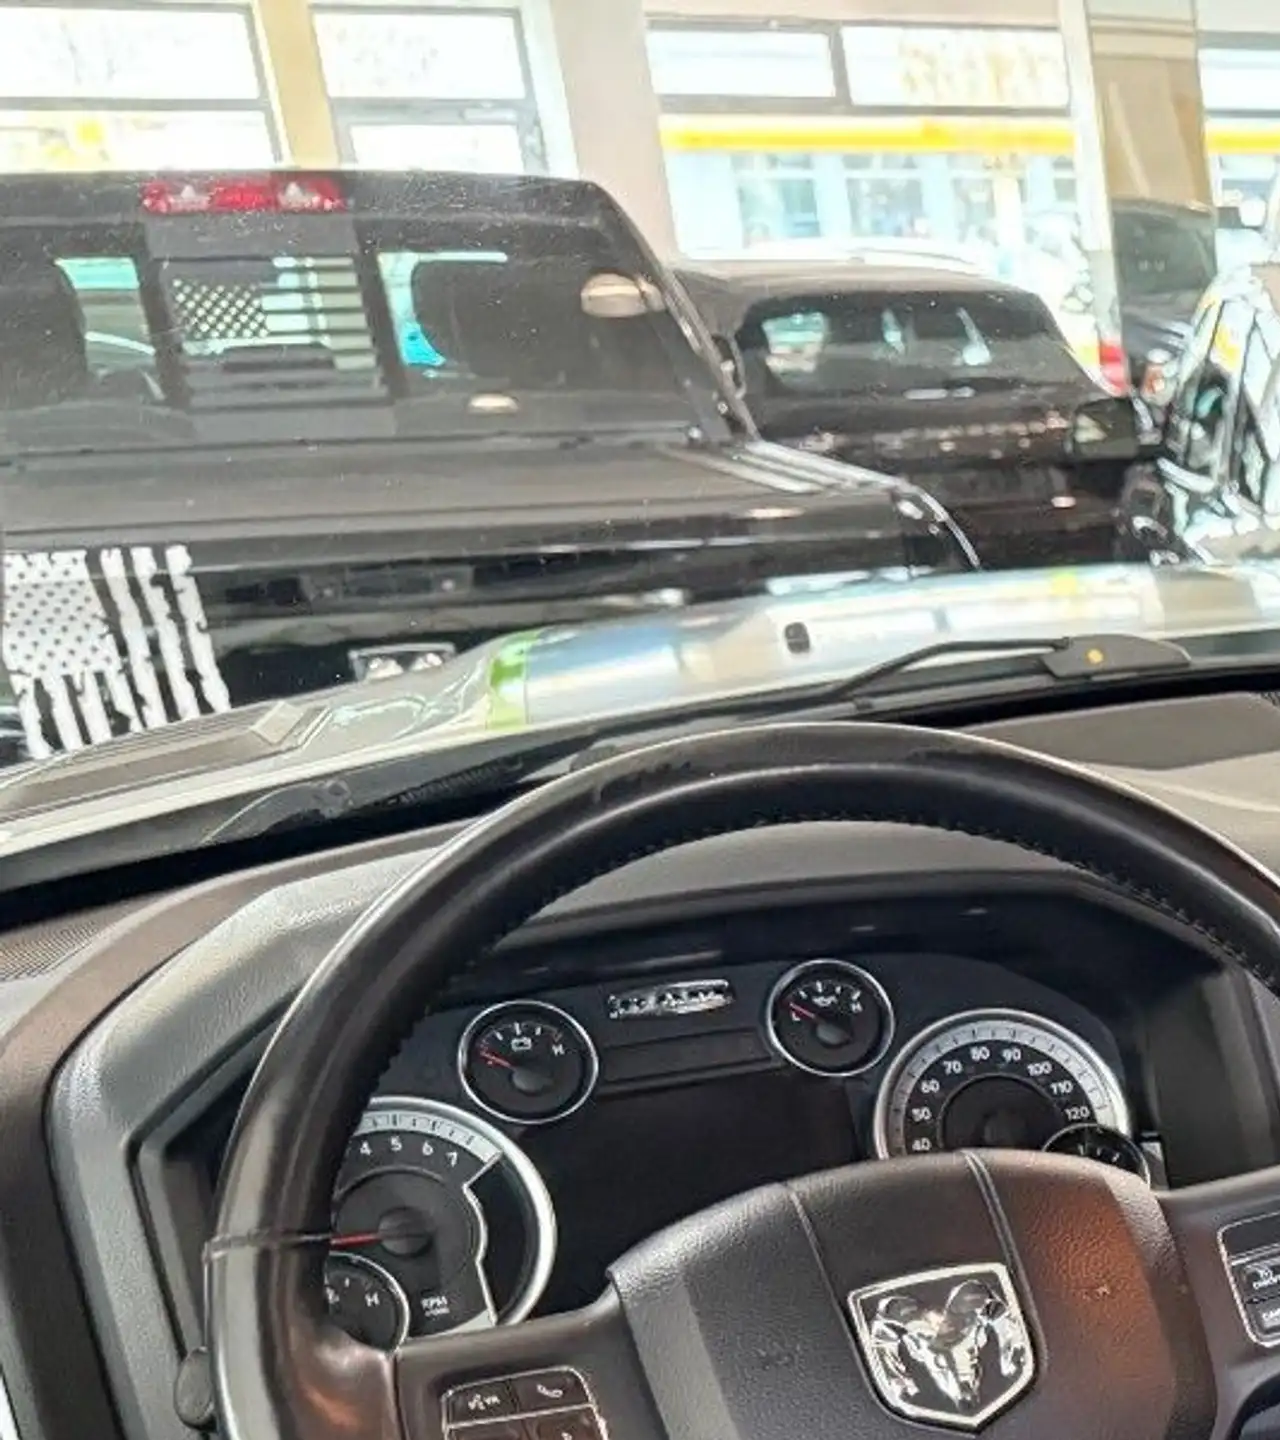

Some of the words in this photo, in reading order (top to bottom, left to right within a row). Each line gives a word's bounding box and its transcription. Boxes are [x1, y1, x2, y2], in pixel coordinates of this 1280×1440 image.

[969, 1046, 990, 1061] 80
[1002, 1048, 1021, 1062] 90
[943, 1060, 962, 1074] 70
[1027, 1062, 1052, 1076] 100
[920, 1079, 940, 1094] 60
[1051, 1081, 1074, 1096] 110
[912, 1107, 931, 1121] 50
[1064, 1107, 1090, 1121] 120
[360, 1142, 371, 1155] 4
[390, 1137, 402, 1151] 5
[422, 1142, 434, 1155] 6
[447, 1151, 458, 1166] 7
[912, 1138, 931, 1151] 40
[421, 1296, 448, 1309] RPM
